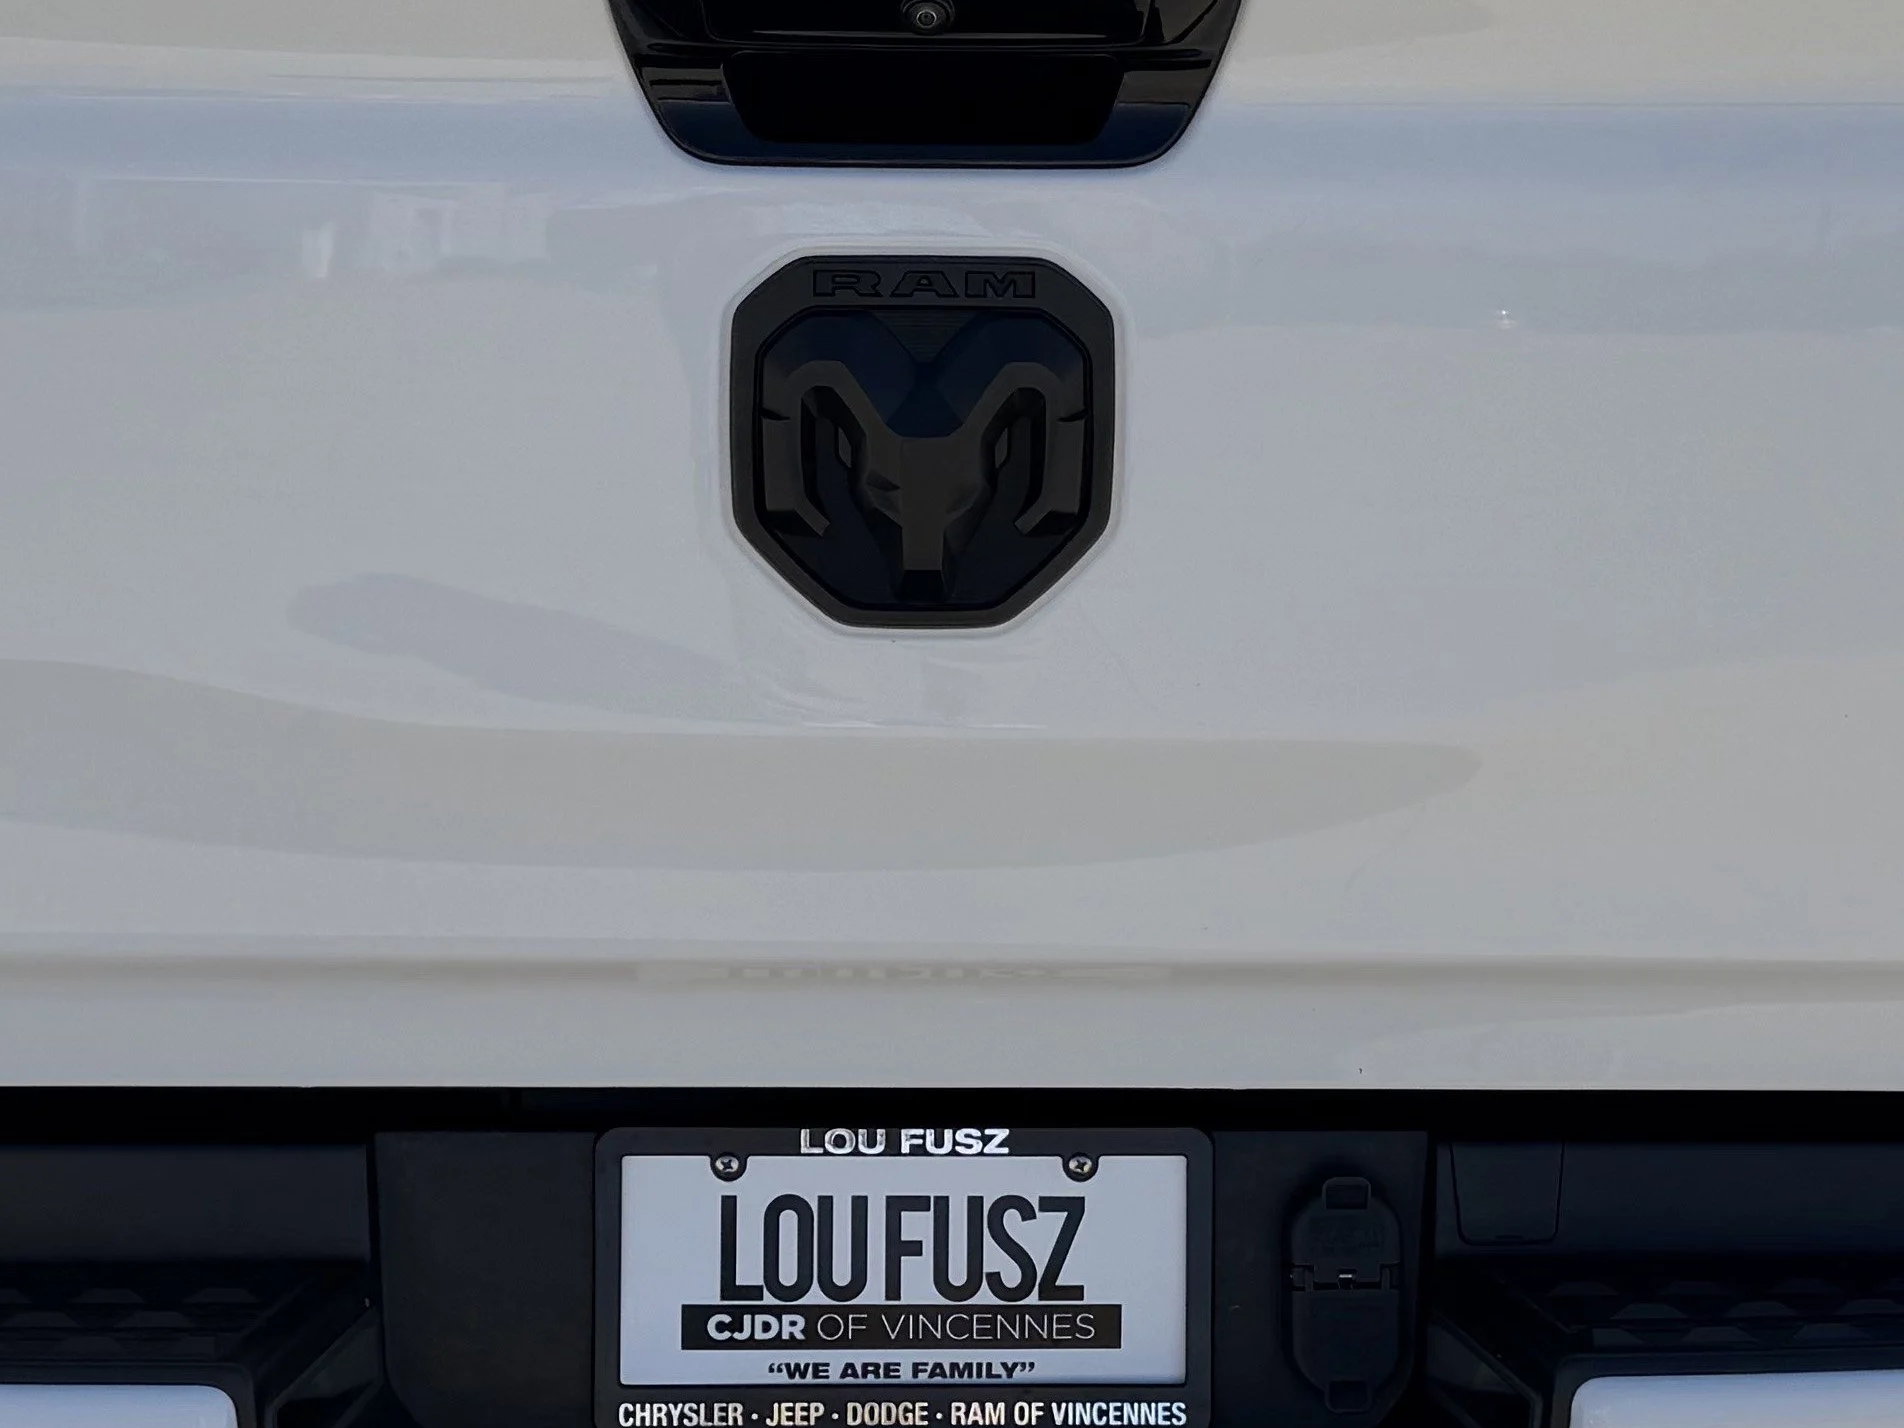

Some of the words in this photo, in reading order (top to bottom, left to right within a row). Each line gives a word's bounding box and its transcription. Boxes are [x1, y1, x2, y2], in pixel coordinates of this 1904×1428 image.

[813, 271, 1036, 298] RAM
[799, 1128, 886, 1155] LOU
[900, 1127, 1010, 1155] FUSZ
[719, 1193, 869, 1303] LOU
[884, 1194, 1086, 1303] FUSZ
[706, 1313, 806, 1341] CJDR
[817, 1313, 868, 1341] OF
[881, 1313, 1095, 1340] VINCENNES
[840, 1361, 902, 1380] ARE
[618, 1402, 744, 1428] CHRYSLER
[765, 1402, 825, 1427] JEEP
[846, 1401, 929, 1426] DODGE
[950, 1401, 1006, 1426] RAM
[1013, 1401, 1045, 1426] OF
[1050, 1401, 1187, 1426] VINCENNES
